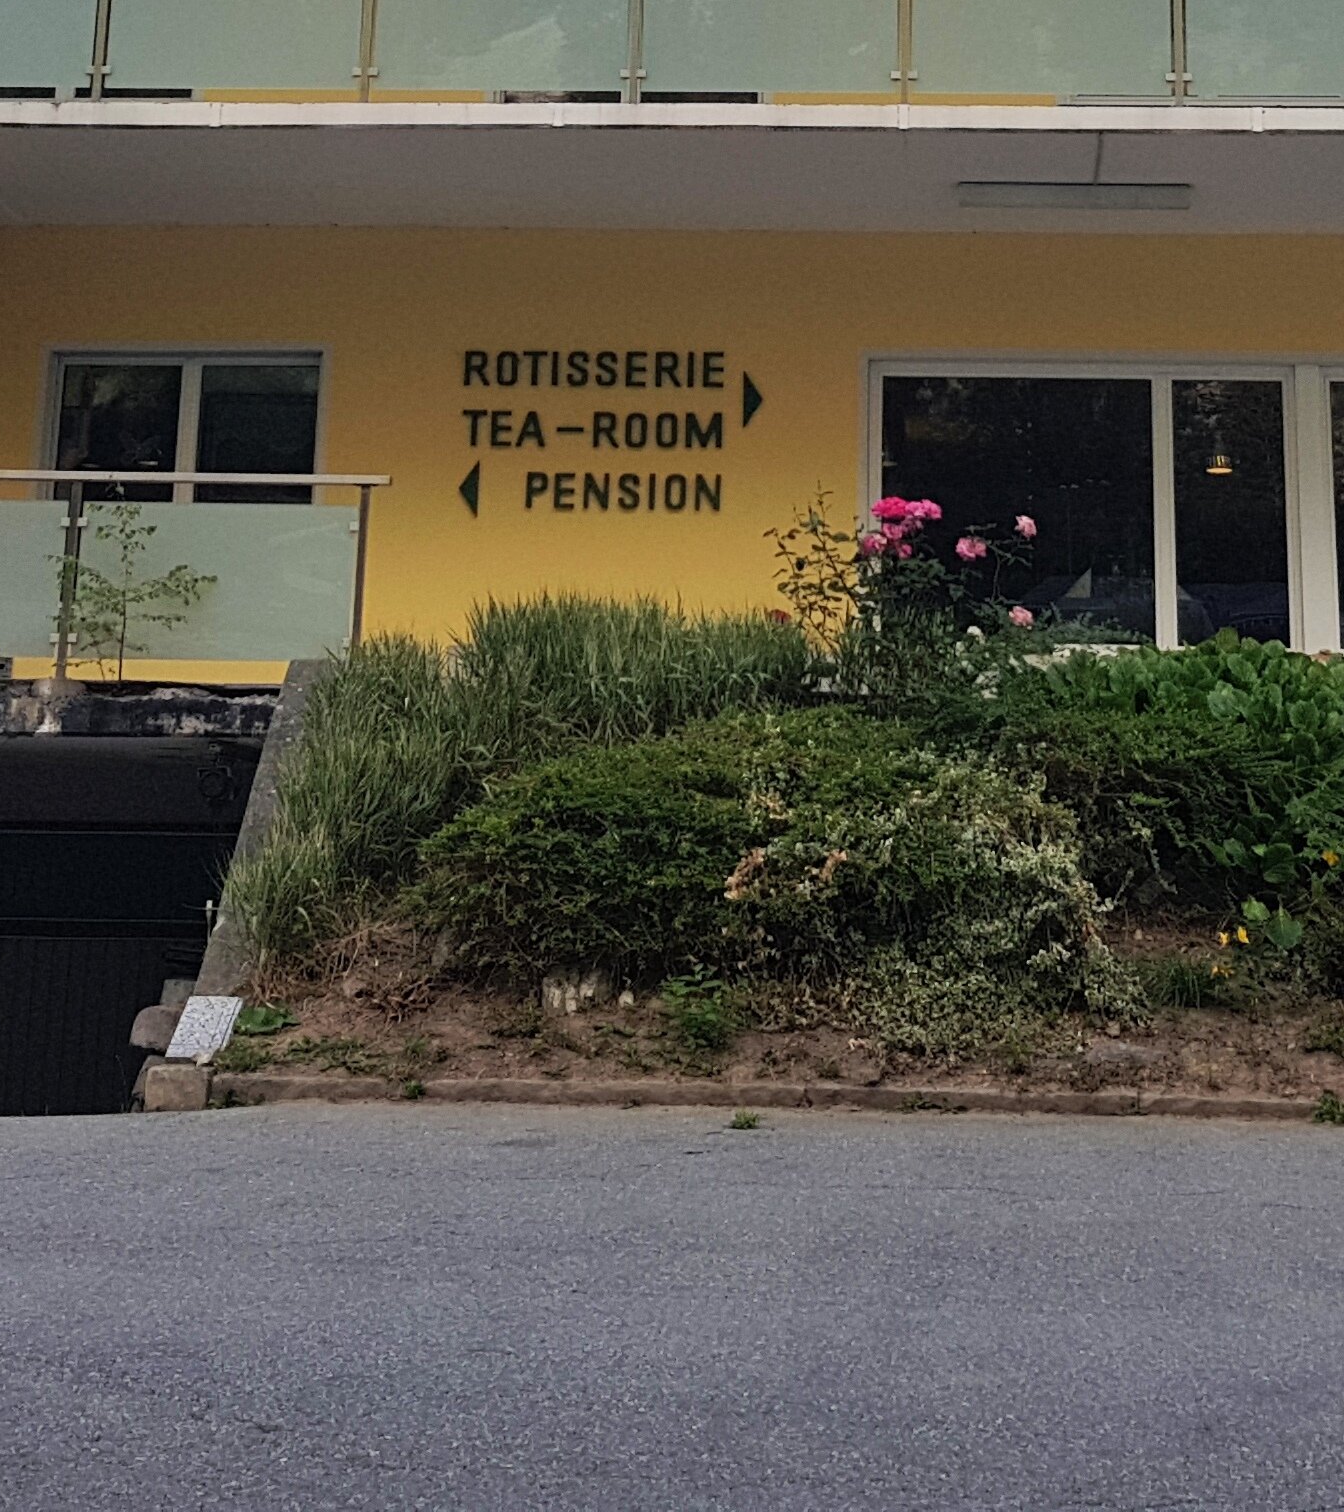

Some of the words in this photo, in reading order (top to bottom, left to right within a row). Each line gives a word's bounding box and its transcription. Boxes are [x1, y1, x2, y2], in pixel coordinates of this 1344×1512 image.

[462, 350, 725, 389] ROTISSERIE
[462, 409, 724, 449] TEA-ROOM
[524, 470, 722, 513] PENSION
